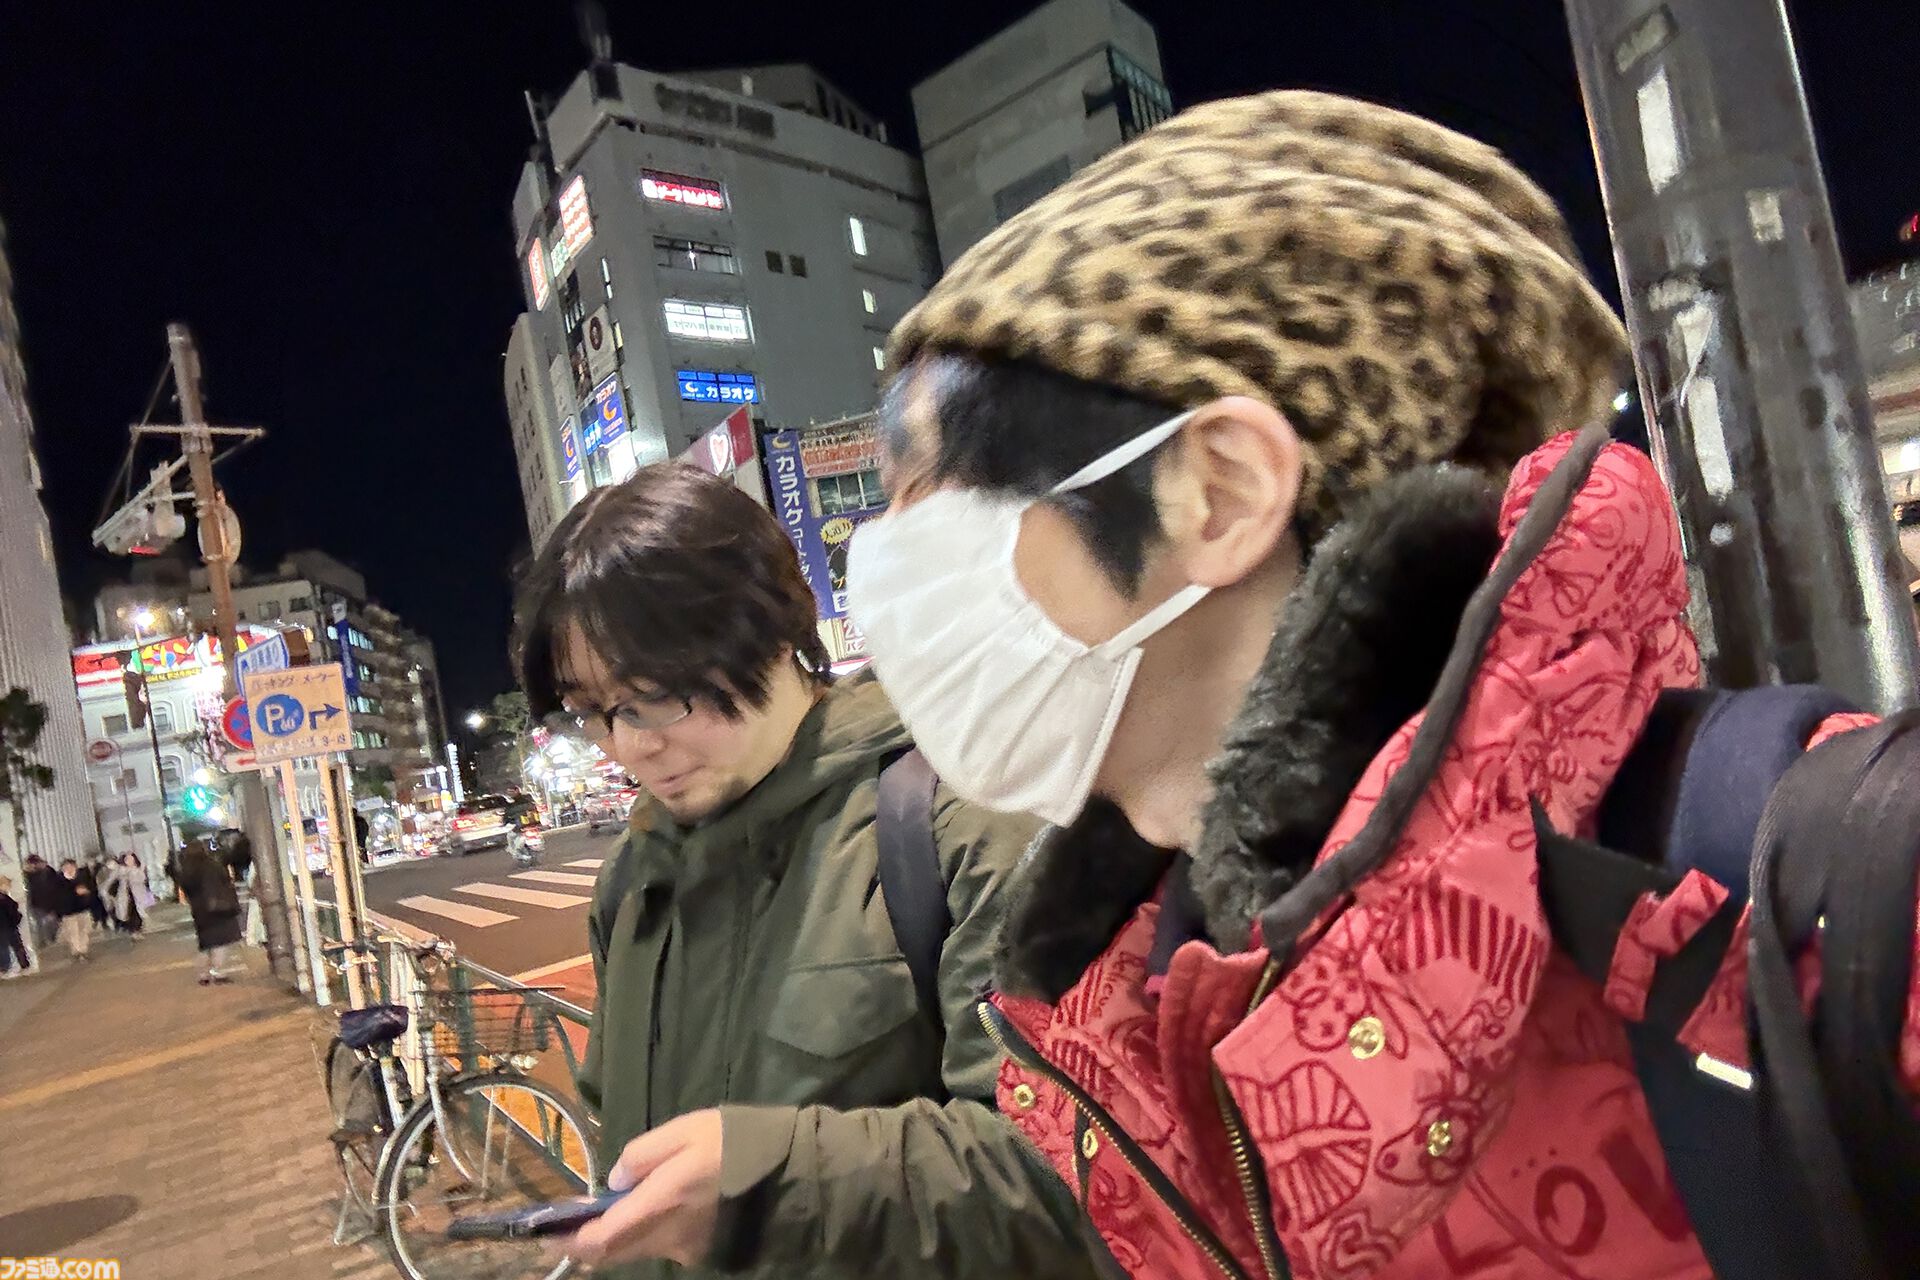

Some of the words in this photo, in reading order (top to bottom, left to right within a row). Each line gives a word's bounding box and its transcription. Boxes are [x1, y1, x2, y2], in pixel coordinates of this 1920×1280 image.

[706, 385, 754, 401] カラオケ
[776, 455, 804, 526] カラオケ
